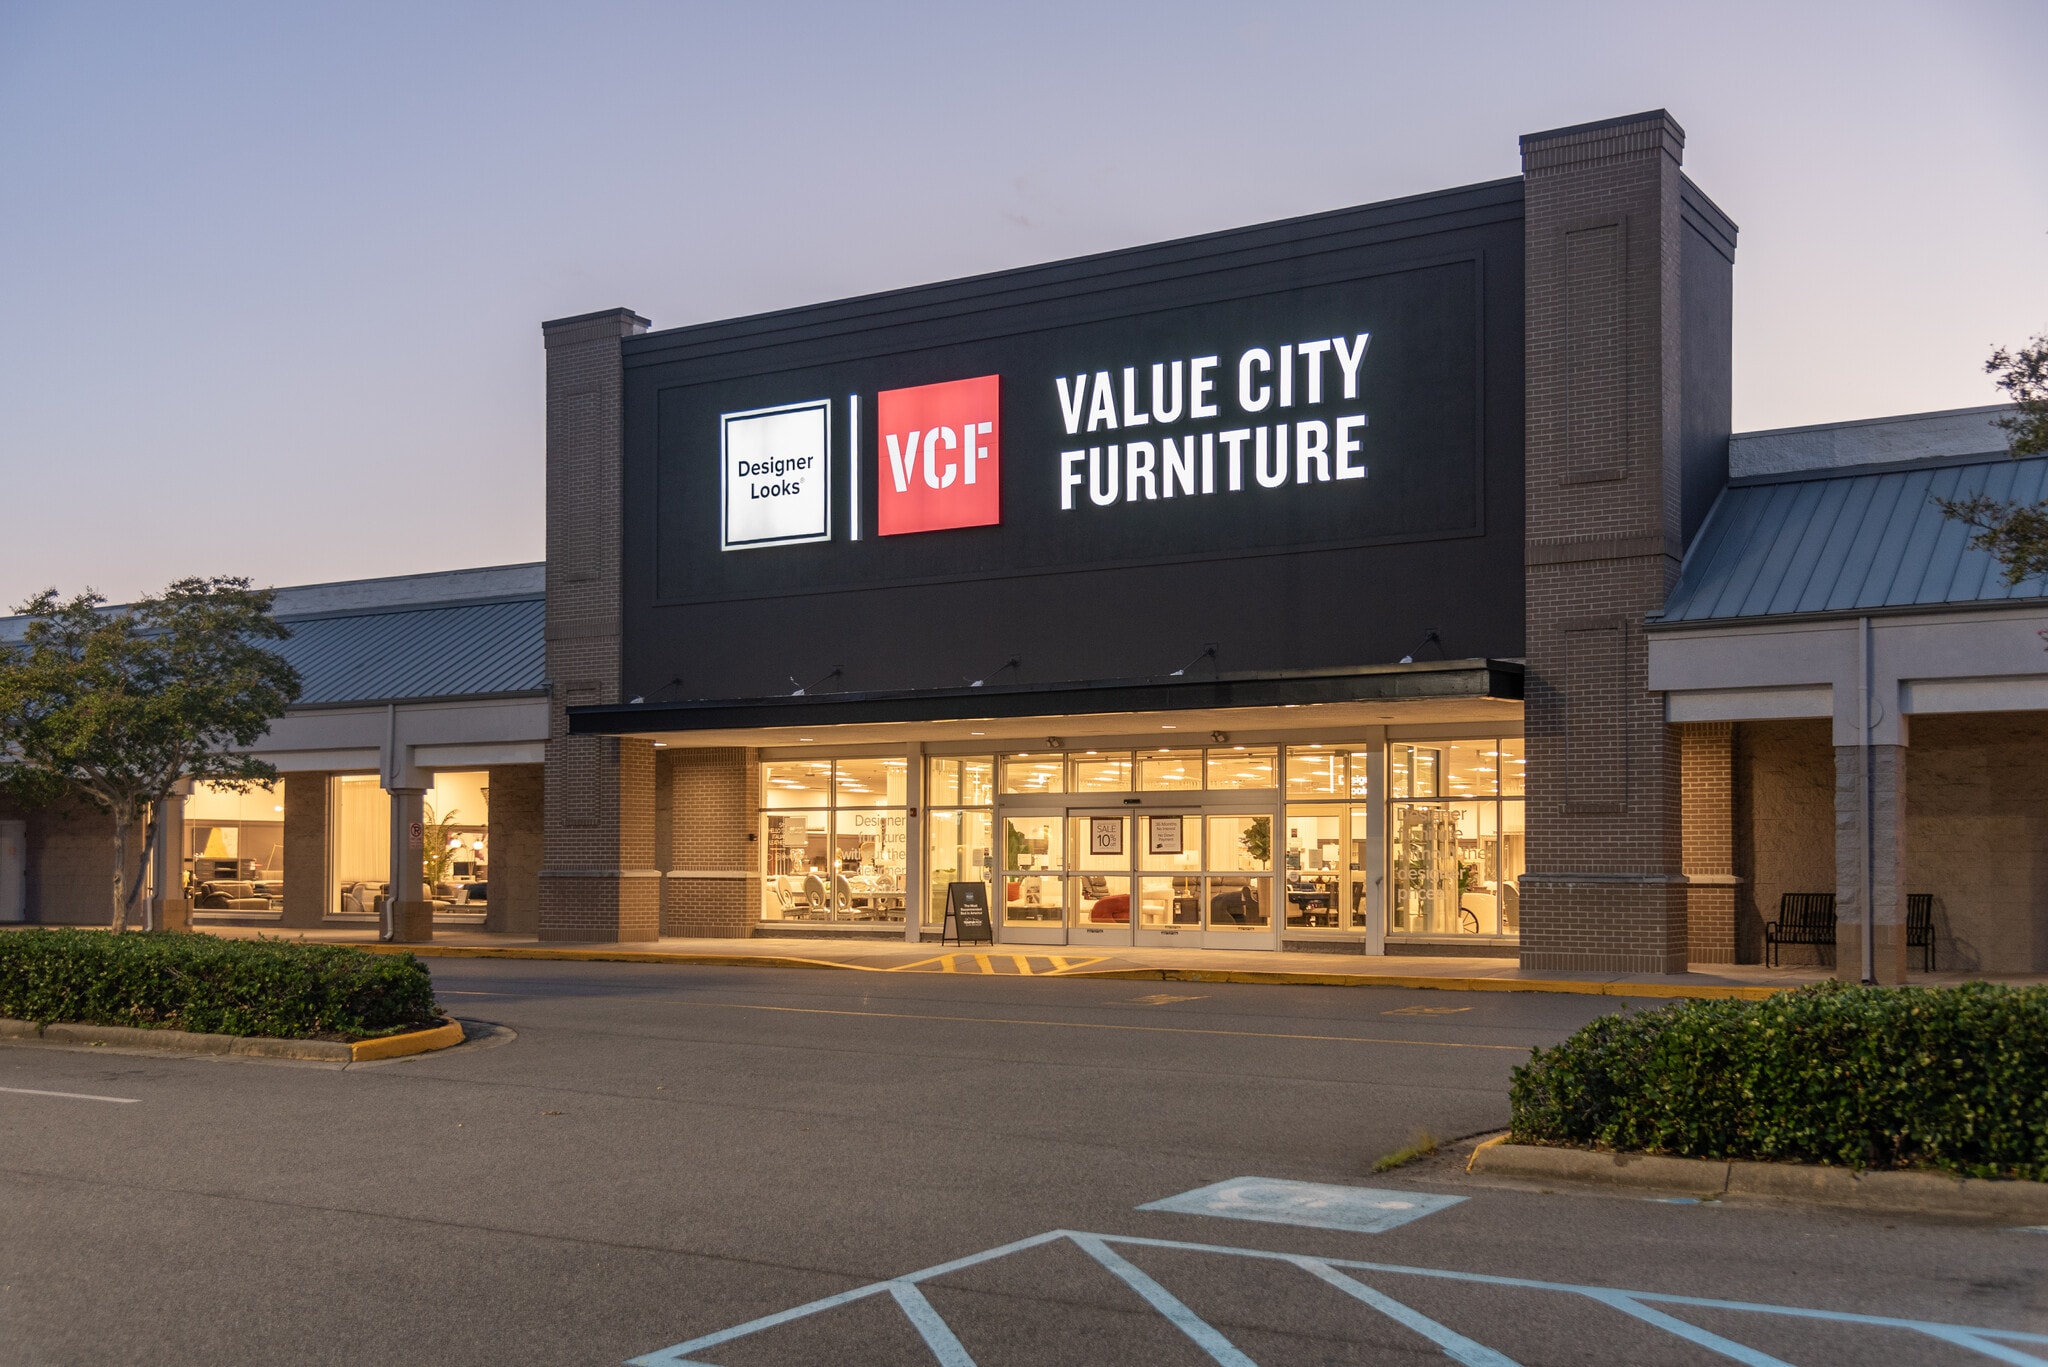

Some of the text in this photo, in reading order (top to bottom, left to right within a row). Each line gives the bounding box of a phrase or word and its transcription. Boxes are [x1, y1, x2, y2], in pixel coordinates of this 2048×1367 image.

[1055, 333, 1371, 435] VALUE CITY
[738, 454, 814, 478] Designer
[885, 421, 993, 493] VCF
[1060, 414, 1367, 510] FURNITURE
[750, 480, 801, 500] Looks
[858, 831, 906, 843] furnture
[1096, 825, 1116, 833] SALE
[842, 848, 906, 860] witut the
